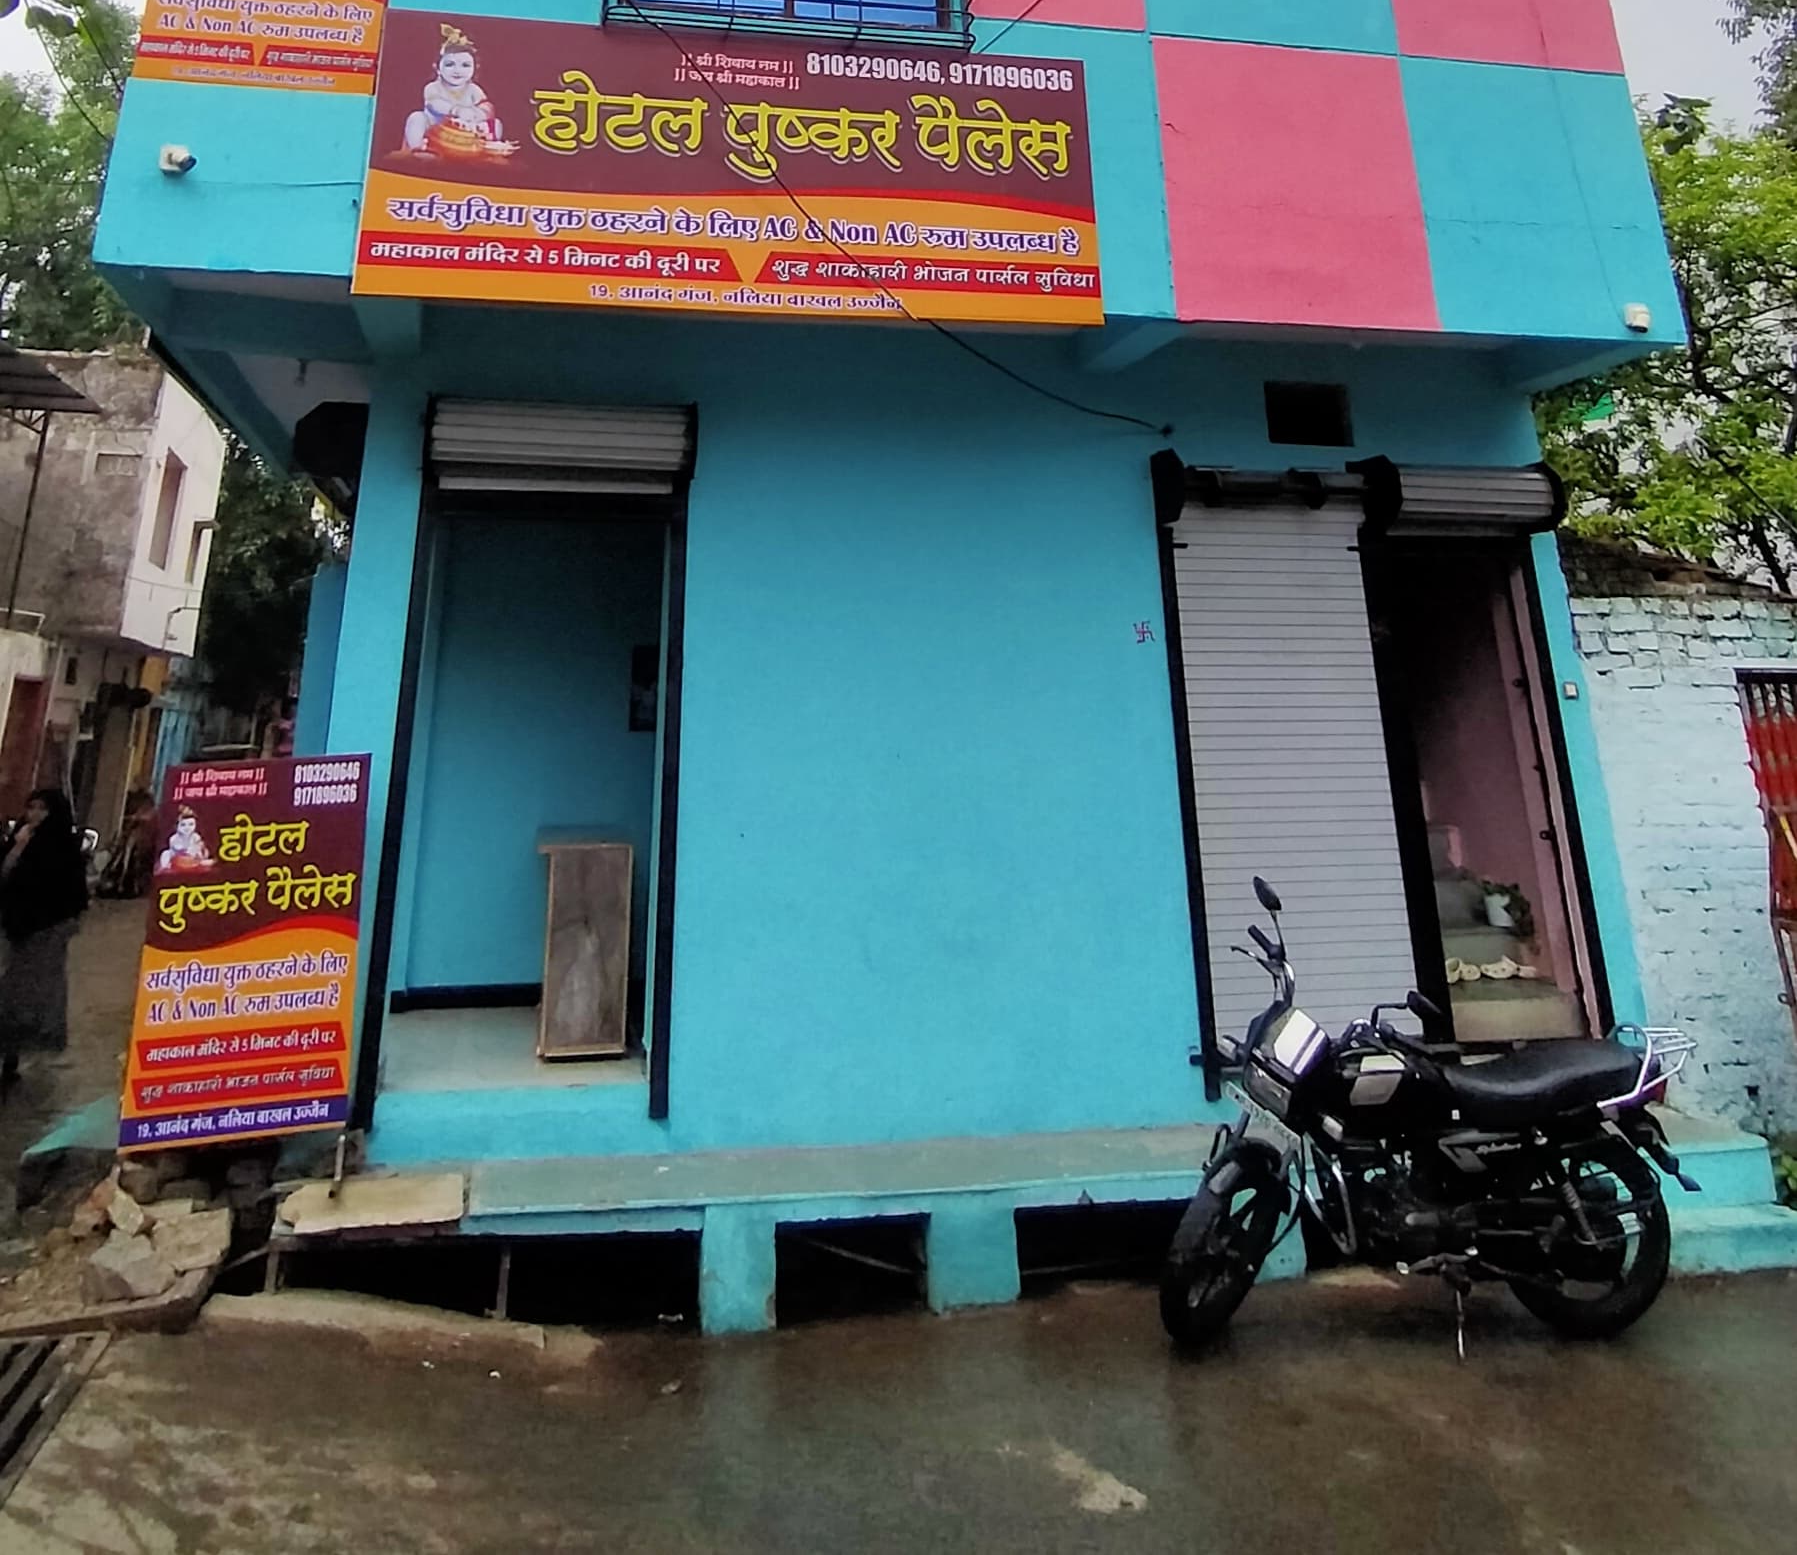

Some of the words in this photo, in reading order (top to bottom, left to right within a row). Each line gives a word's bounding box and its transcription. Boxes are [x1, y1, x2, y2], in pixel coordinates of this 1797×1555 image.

[203, 17, 231, 32] Non
[352, 27, 364, 45] है
[323, 4, 339, 20] के
[343, 5, 374, 24] लिए
[735, 73, 786, 88] महाकाल
[806, 53, 946, 85] 8103290646,
[949, 61, 1074, 91] 9171896036
[532, 70, 709, 151] होटल
[724, 101, 902, 181] पुष्कर
[909, 94, 1073, 176] पैलेस
[388, 194, 529, 232] सर्वसुविधा
[531, 207, 584, 236] युक्त
[589, 205, 669, 236] ठहरने
[673, 207, 704, 237] के
[708, 209, 758, 241] लिए
[763, 216, 797, 242] AC
[803, 219, 826, 244] &
[828, 220, 877, 246] Non
[883, 222, 917, 247] AC
[971, 229, 1057, 255] उपलब्ध
[1059, 226, 1081, 257] है
[370, 241, 459, 261] महाकाल
[465, 242, 519, 265] मंदिर
[523, 245, 544, 265] से
[548, 250, 559, 265] 5
[564, 246, 620, 268] मिनट
[625, 248, 651, 270] की
[655, 249, 690, 277] दूरी
[694, 257, 721, 274] पर
[772, 259, 809, 282] शुद्ध
[816, 260, 908, 281] शाकाहारी
[914, 260, 968, 283] भोजन
[975, 264, 1028, 287] पार्सल
[1034, 268, 1095, 292] सुविधा
[619, 284, 673, 302] आनंद
[723, 286, 782, 306] नलिया
[846, 292, 902, 311] उज्जैन
[294, 762, 360, 784] 8103290646
[293, 784, 357, 806] 9171896036
[219, 813, 310, 862] होटल
[159, 879, 260, 933] पुष्कर
[267, 865, 356, 911] पैलेस
[146, 961, 220, 994] सर्वसुविधा
[223, 963, 251, 990] युक्त
[255, 953, 298, 981] ठहरने
[301, 952, 316, 975] के
[320, 949, 348, 975] लिए
[148, 1001, 165, 1022] AC
[172, 1000, 182, 1021] &
[188, 999, 216, 1019] Non
[222, 995, 239, 1016] AC
[274, 989, 325, 1011] उपलब्ध
[328, 982, 340, 1008] है
[146, 1045, 195, 1062] महाकाल
[197, 1037, 226, 1058] मंदिर
[229, 1035, 239, 1053] से
[241, 1039, 248, 1053] 5
[250, 1033, 280, 1051] मिनट
[283, 1030, 298, 1047] की
[300, 1027, 319, 1051] दूरी
[321, 1030, 336, 1044] पर
[155, 1114, 189, 1136] आनंद
[218, 1108, 255, 1129] नलिया
[293, 1100, 329, 1121] उज्जैन
